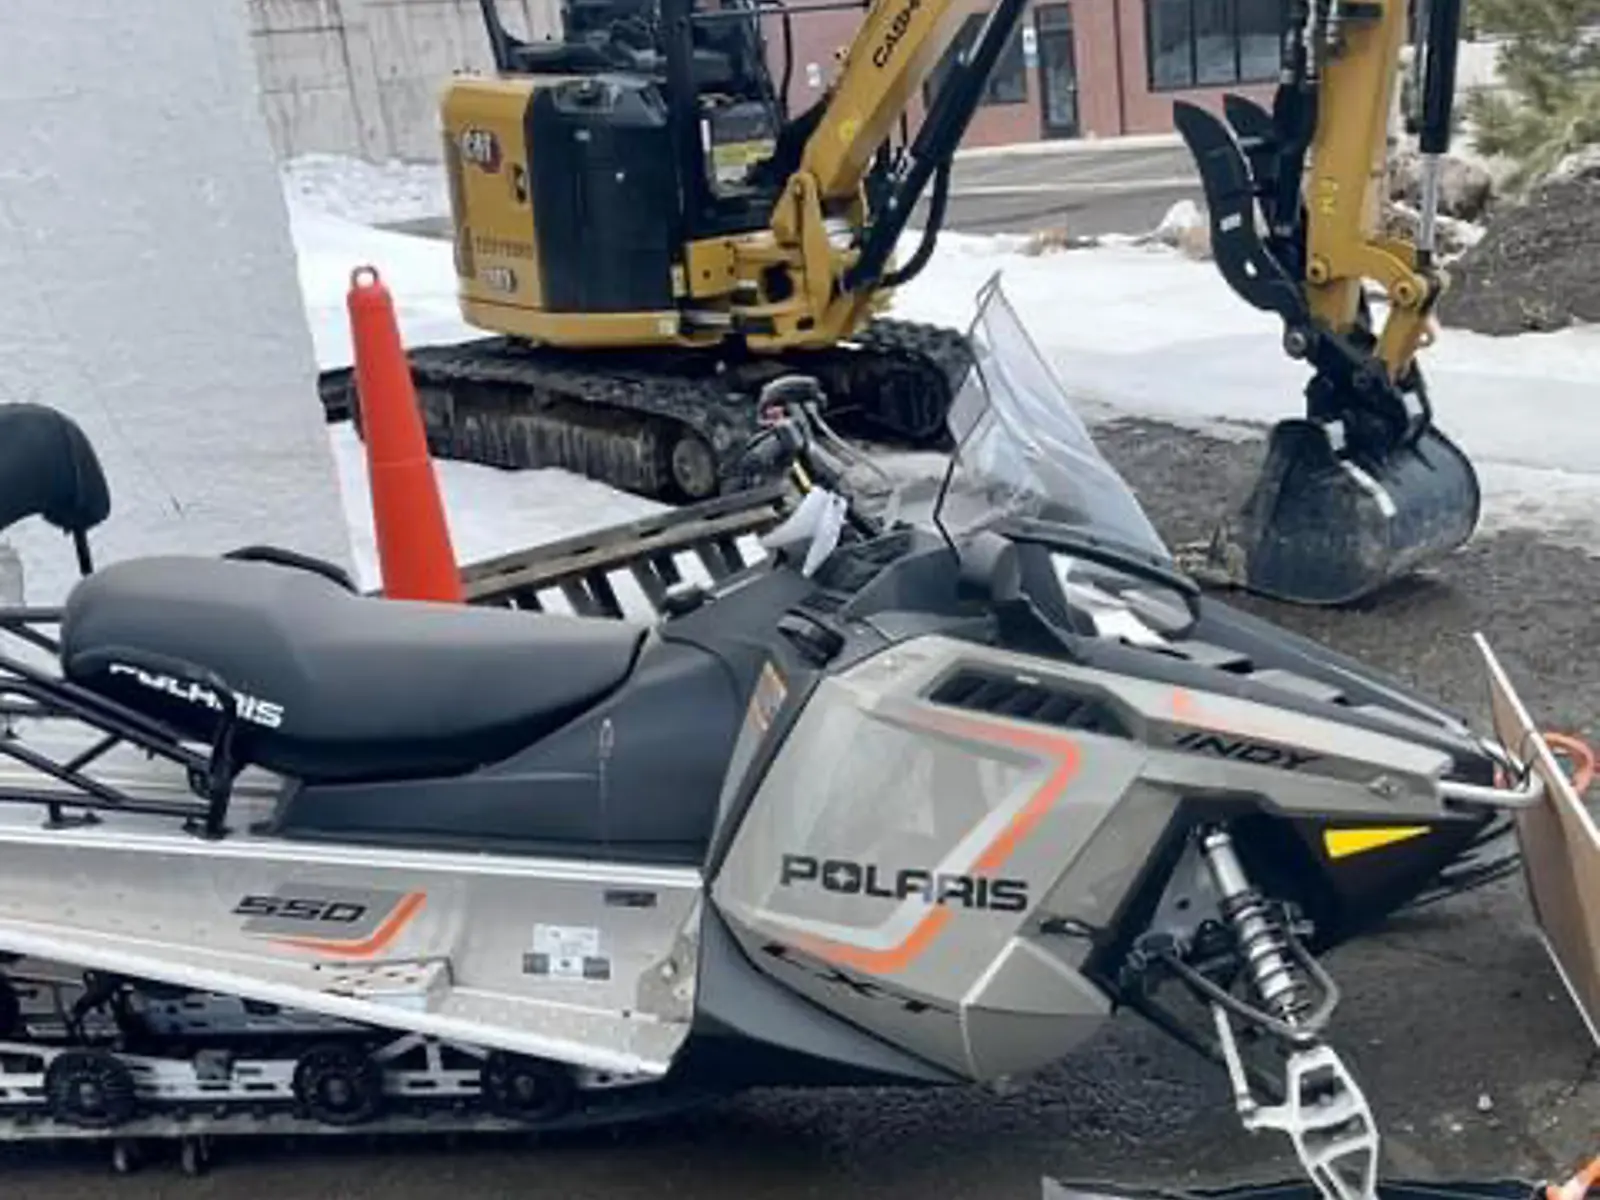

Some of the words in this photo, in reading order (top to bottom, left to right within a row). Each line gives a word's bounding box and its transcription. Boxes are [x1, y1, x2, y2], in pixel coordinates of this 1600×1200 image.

[1174, 731, 1322, 770] INDY
[780, 853, 1028, 912] POLARIS
[231, 895, 367, 923] 550
